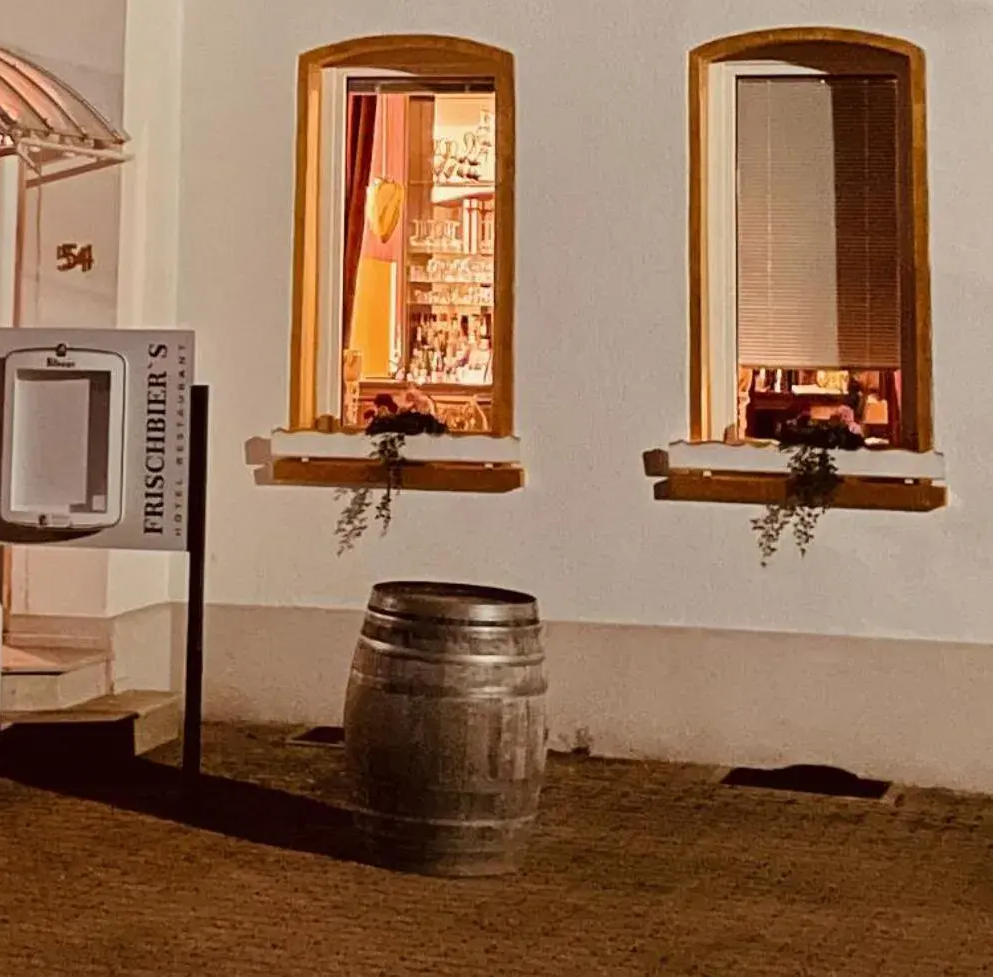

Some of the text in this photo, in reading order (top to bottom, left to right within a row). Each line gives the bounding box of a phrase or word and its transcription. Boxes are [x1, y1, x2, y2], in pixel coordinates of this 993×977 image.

[56, 241, 94, 273] 54
[174, 343, 187, 537] HOTEL RESTAURANT
